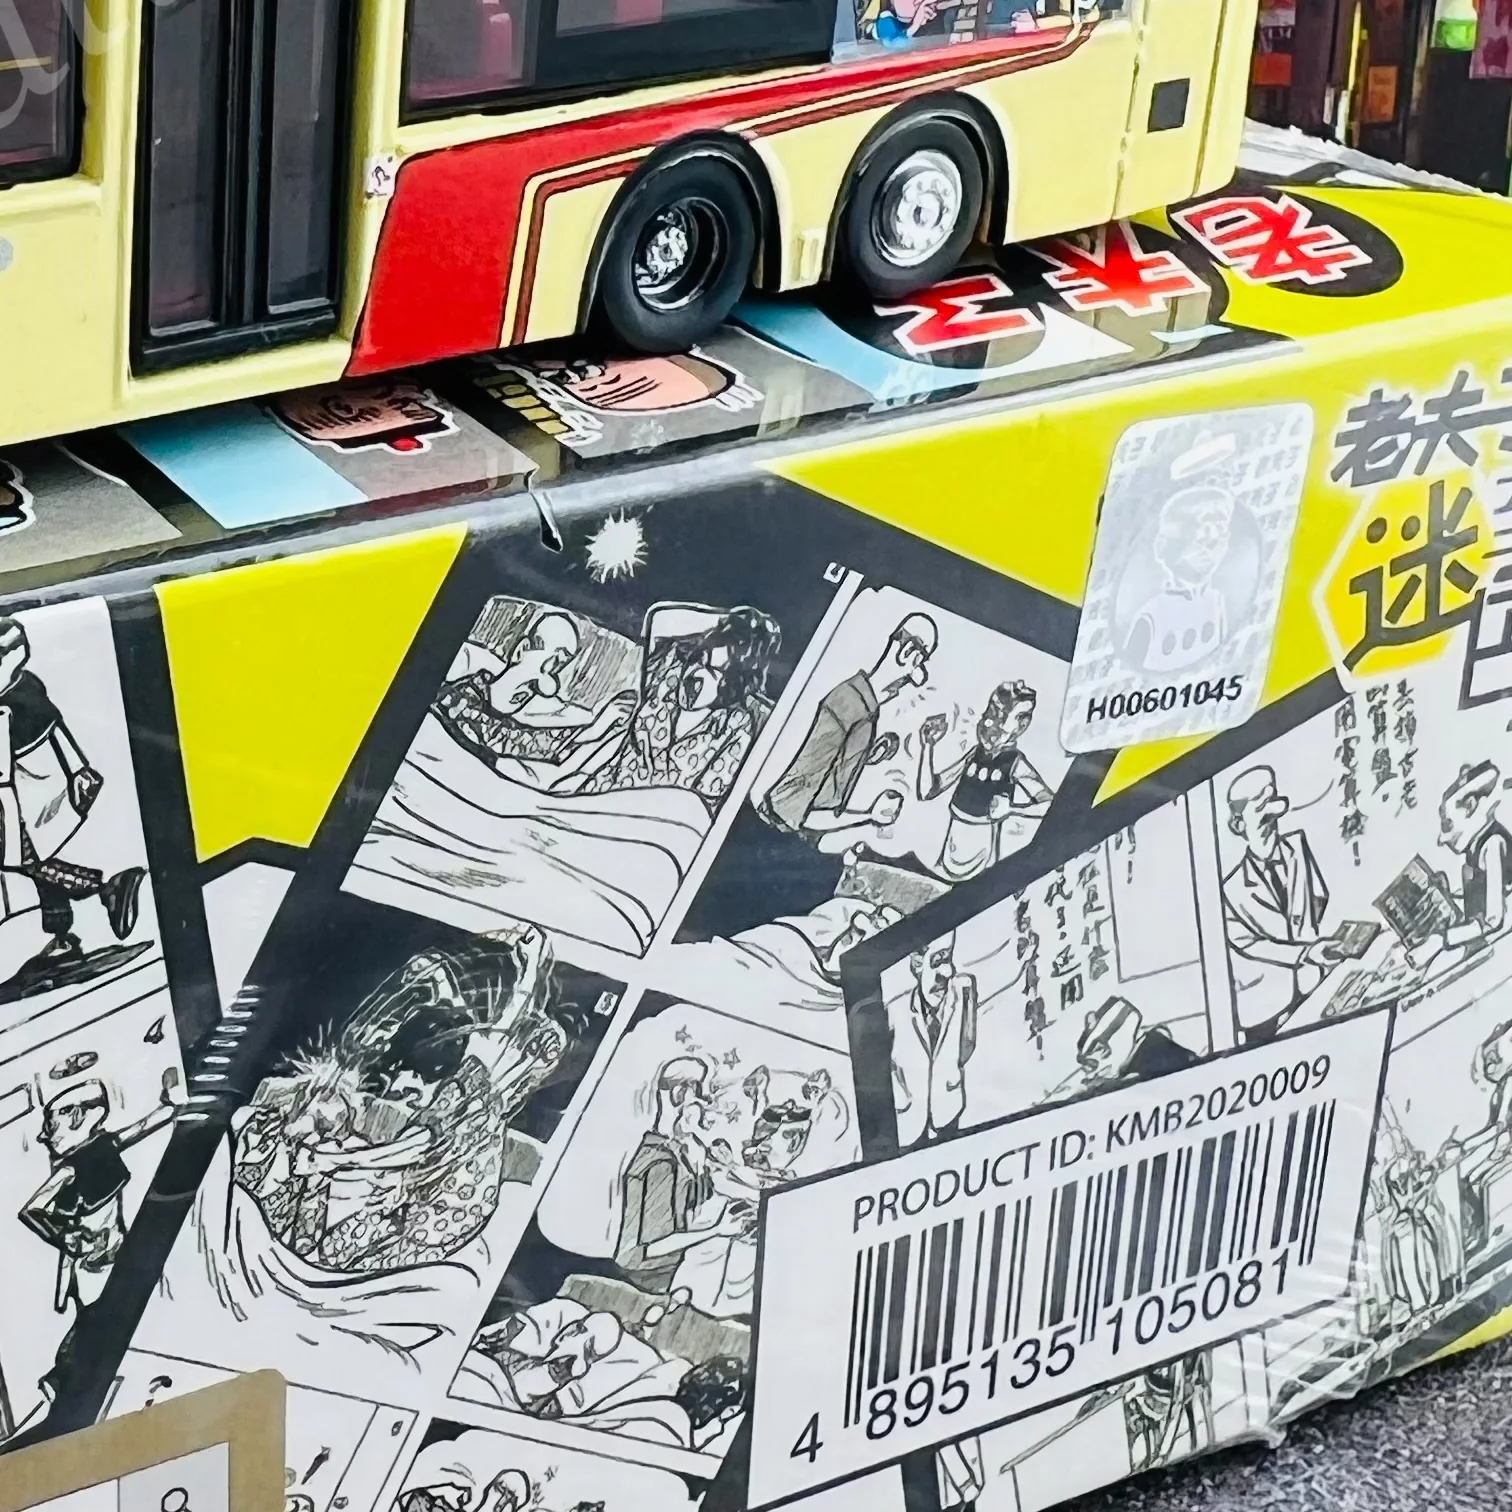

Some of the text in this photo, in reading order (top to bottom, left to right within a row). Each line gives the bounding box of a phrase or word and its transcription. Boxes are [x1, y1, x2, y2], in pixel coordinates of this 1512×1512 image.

[1087, 674, 1244, 725] H00601045
[852, 1054, 1332, 1234] PRODUCT ID: KMB2020009
